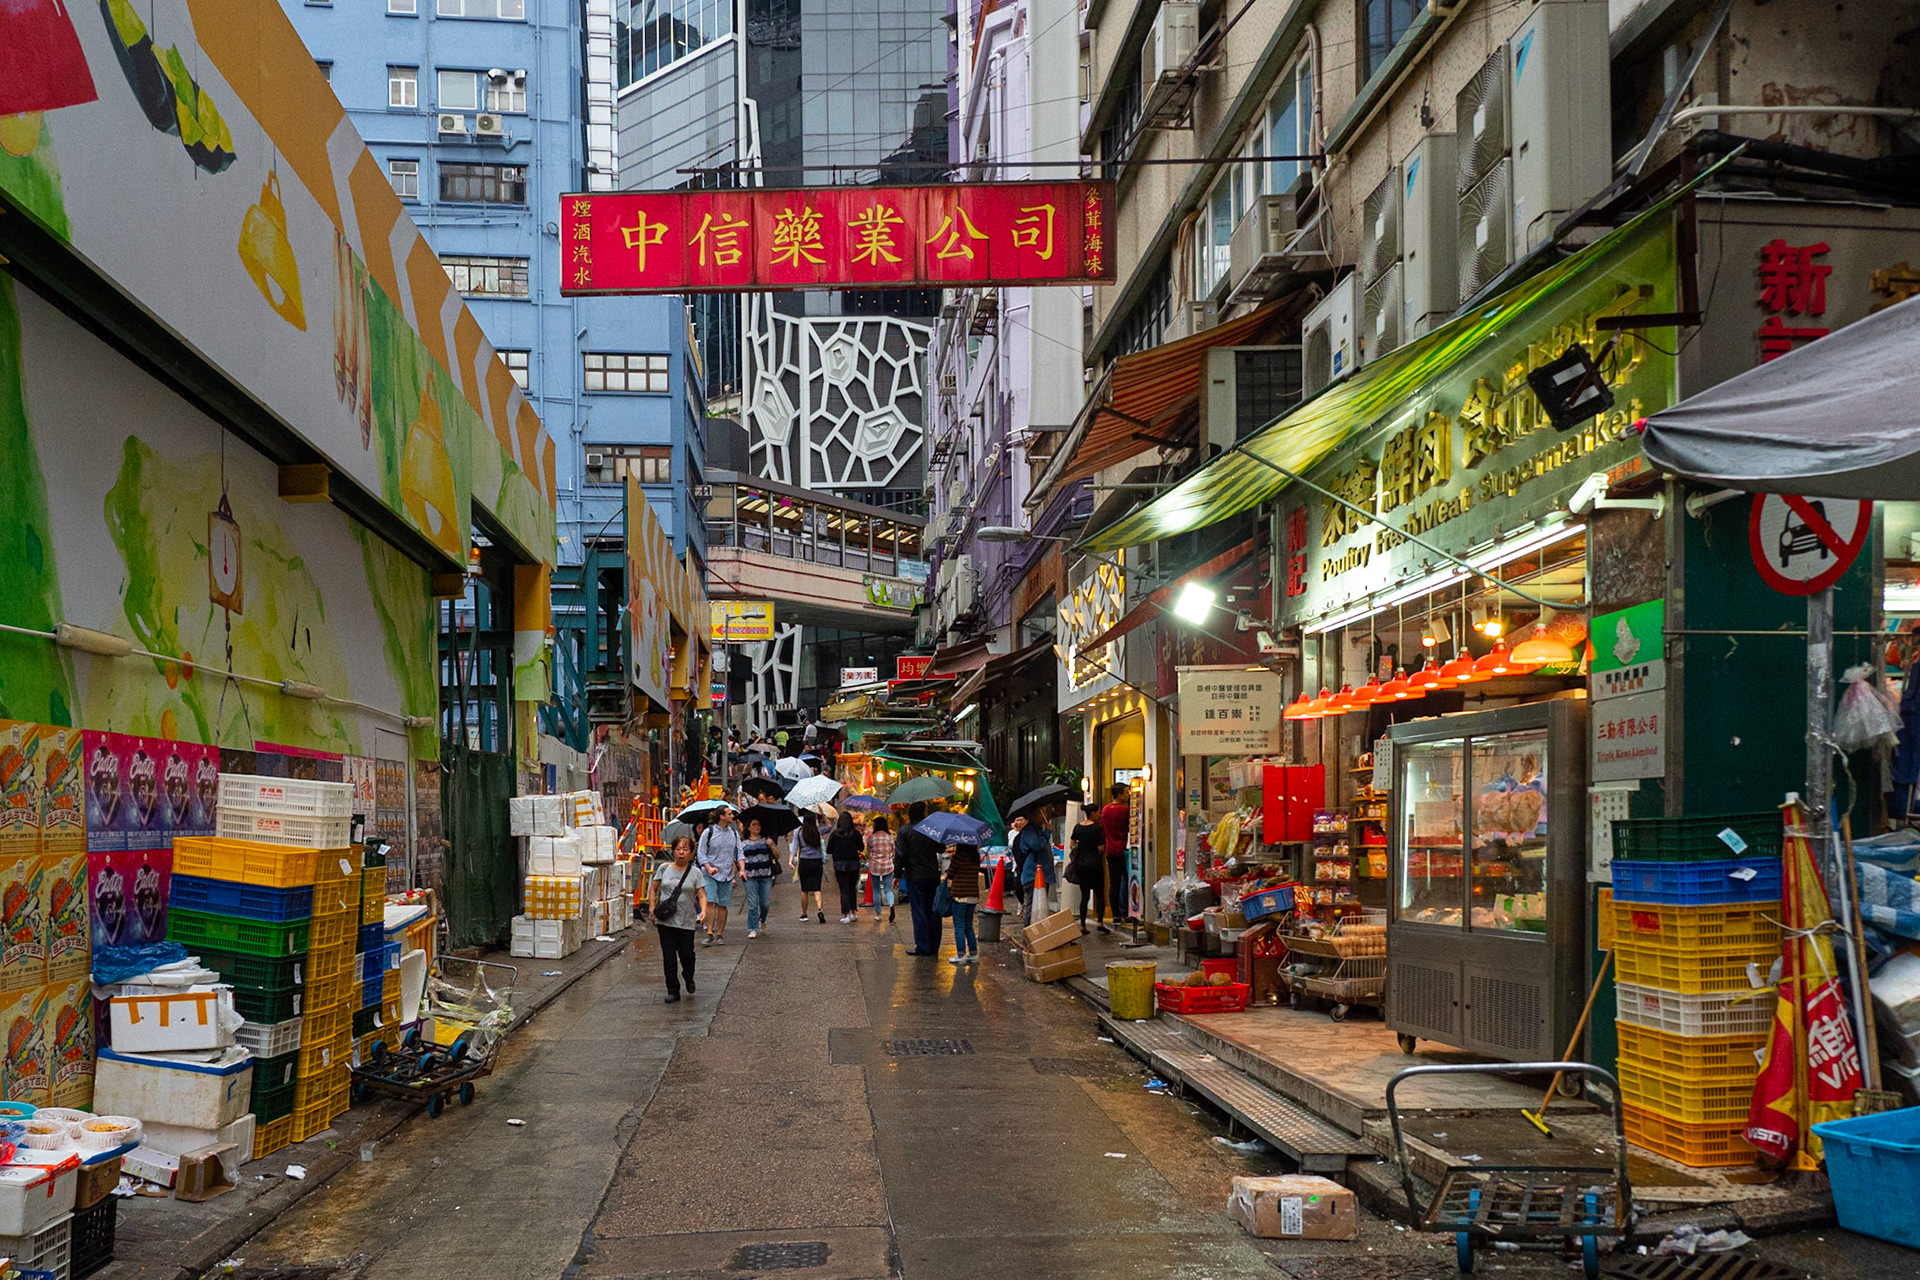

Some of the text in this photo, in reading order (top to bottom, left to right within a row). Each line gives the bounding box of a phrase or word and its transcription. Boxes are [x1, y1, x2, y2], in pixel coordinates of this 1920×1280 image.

[572, 200, 592, 285] 煙酒汽水
[620, 203, 1057, 272] 中信藥業公司
[1321, 398, 1645, 582] Poultry Fresh Meat Supermarket
[47, 810, 82, 825] EASTER
[5, 945, 43, 963] EASTER
[52, 937, 87, 955] EASTER
[56, 1062, 93, 1083] EASTER
[9, 1076, 47, 1098] EASTER
